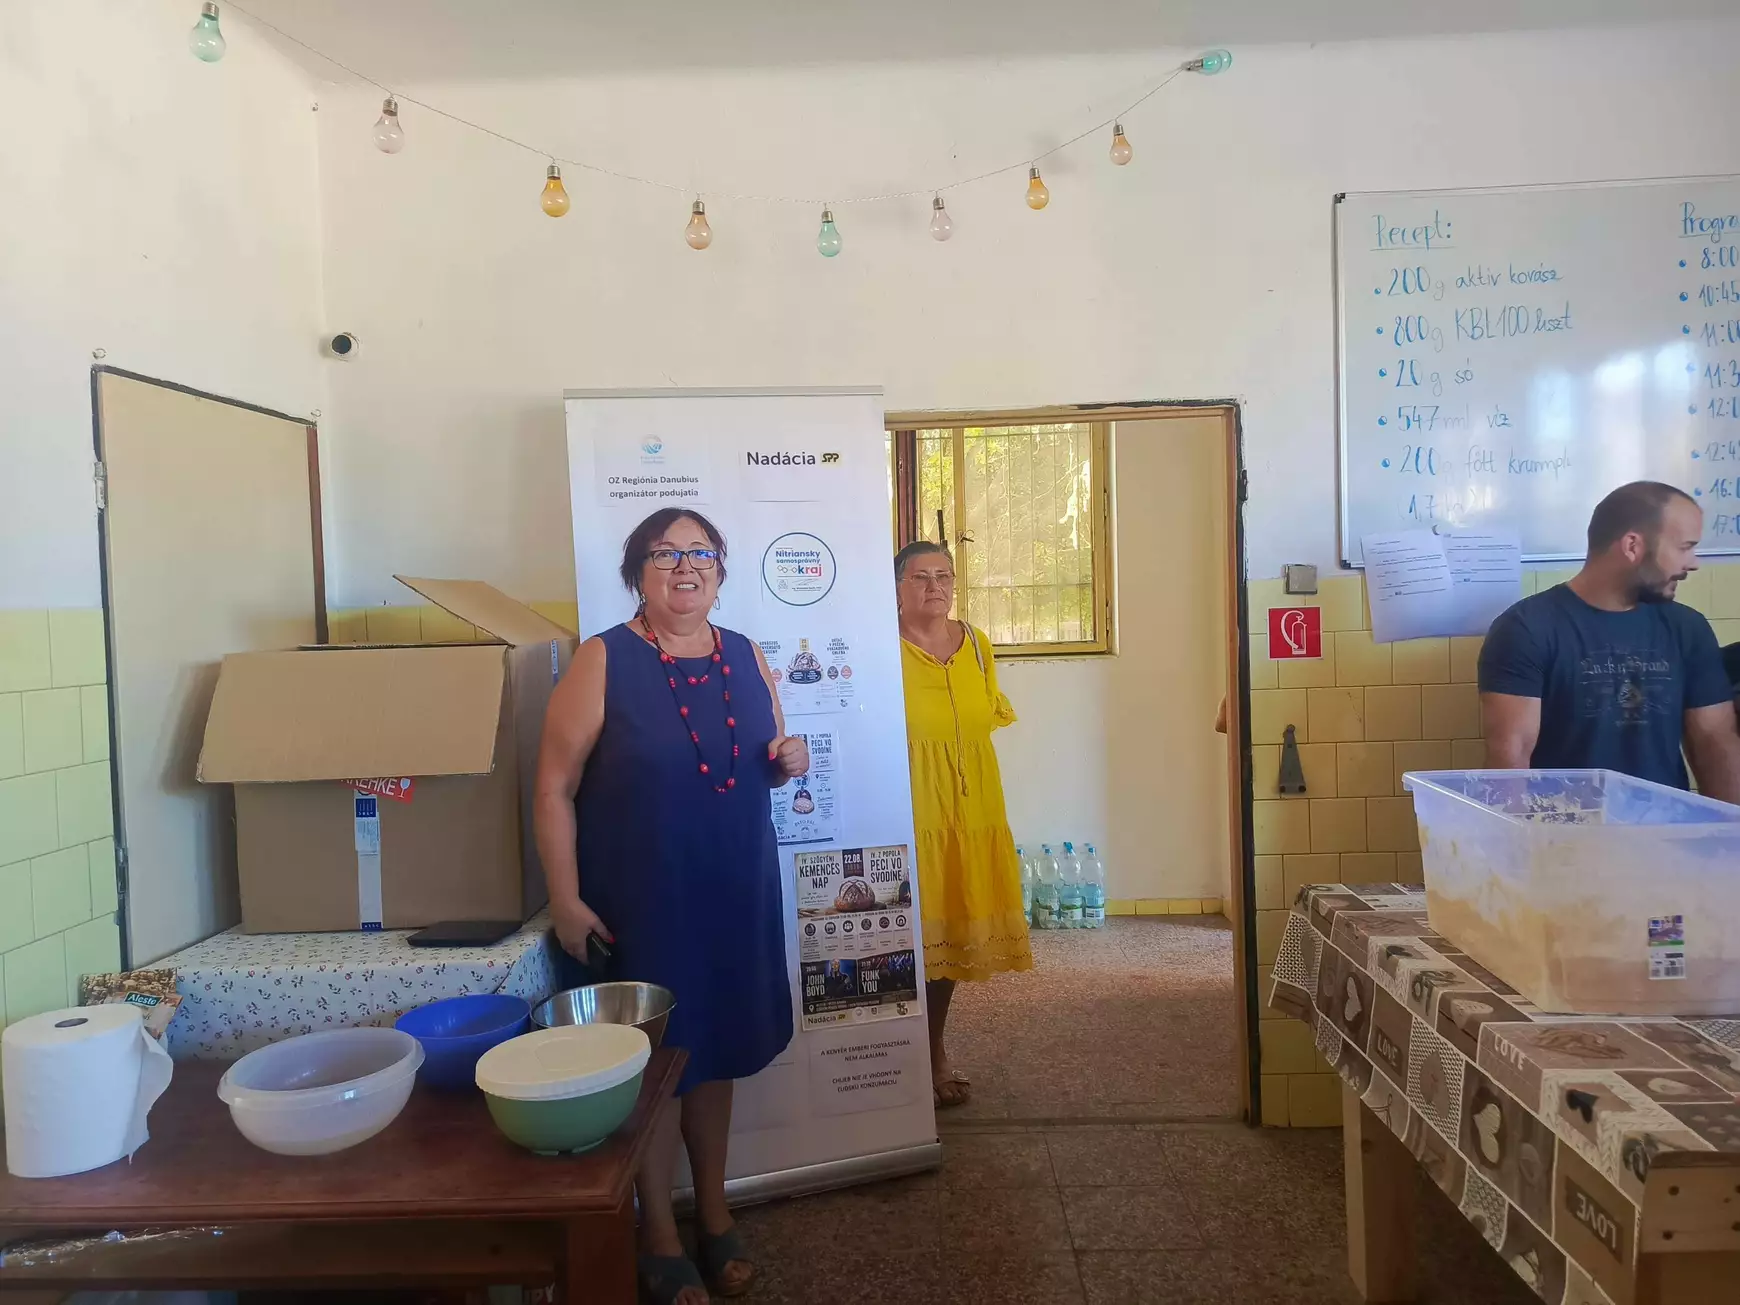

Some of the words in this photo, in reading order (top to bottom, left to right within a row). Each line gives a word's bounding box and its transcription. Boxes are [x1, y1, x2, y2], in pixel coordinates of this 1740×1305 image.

[1371, 210, 1451, 250] Recept:
[747, 451, 816, 465] Nadácia
[821, 453, 840, 463] SPP
[608, 476, 620, 484] OZ
[622, 476, 658, 486] Regiónia
[660, 475, 699, 484] Danubius
[609, 490, 658, 500] organizátor
[659, 488, 699, 498] podujatia
[776, 550, 820, 558] Nitriansky
[798, 564, 822, 576] kraj
[870, 858, 888, 871] PECI
[891, 857, 902, 869] VO
[812, 877, 828, 889] NAP
[870, 869, 902, 884] SVODÍNE
[806, 973, 825, 986] JOHN
[861, 969, 880, 981] FUNK
[806, 984, 825, 997] BOYD
[862, 980, 878, 993] YOU
[128, 993, 157, 1006] Alesto
[808, 1015, 836, 1024] Nadácia
[1494, 1034, 1526, 1071] LOVE
